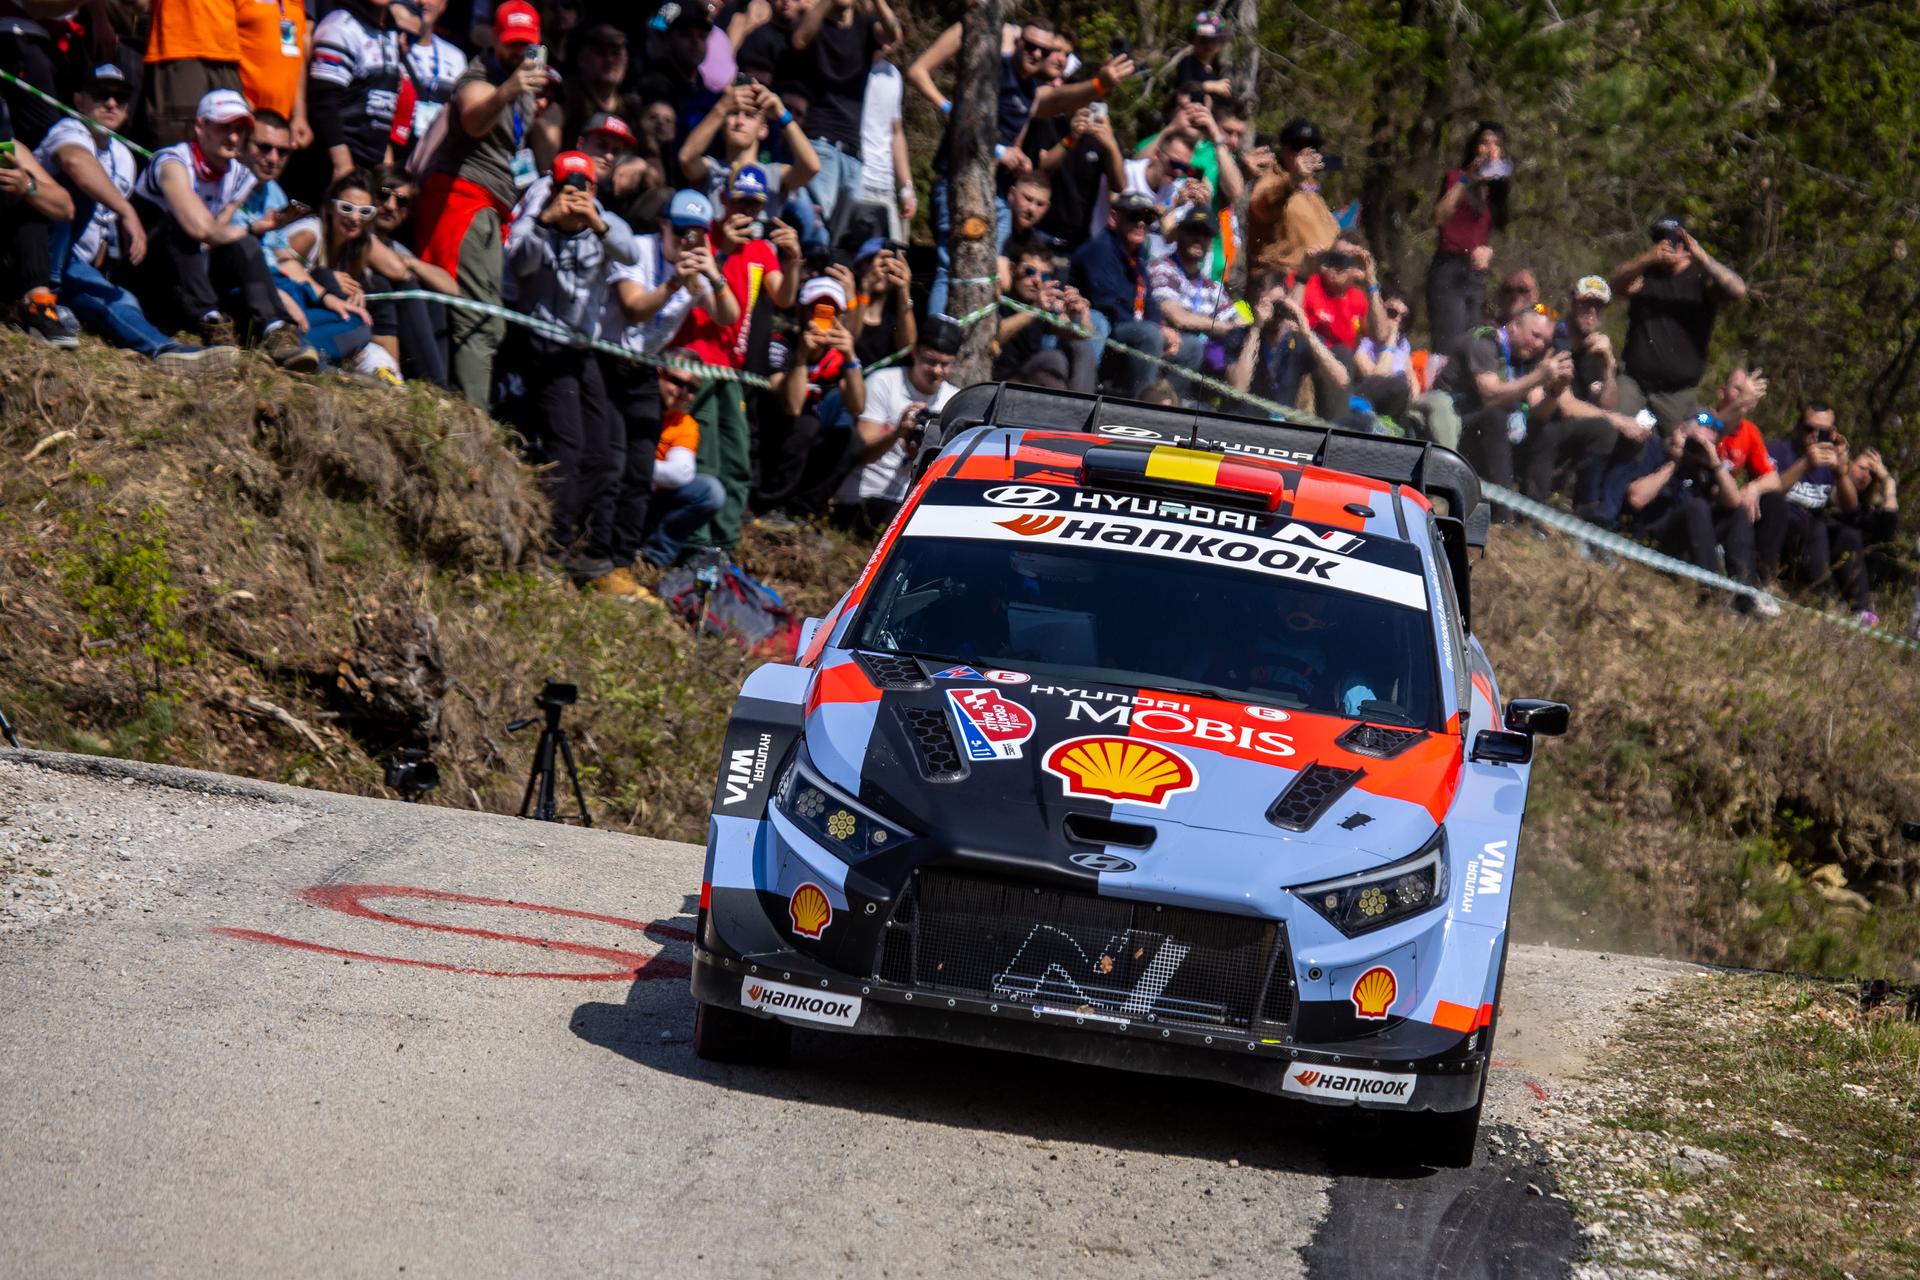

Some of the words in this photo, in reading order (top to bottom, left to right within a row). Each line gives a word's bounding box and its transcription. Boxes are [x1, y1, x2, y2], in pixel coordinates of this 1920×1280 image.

[1073, 492, 1257, 532] HYUNDAI
[992, 704, 1013, 733] CROATIA
[1030, 684, 1191, 713] HYUNDAI
[981, 711, 1001, 732] RALLY
[1065, 700, 1297, 757] MOBIS
[752, 733, 772, 782] HYUNDAI
[1461, 860, 1479, 913] HYUNDAI
